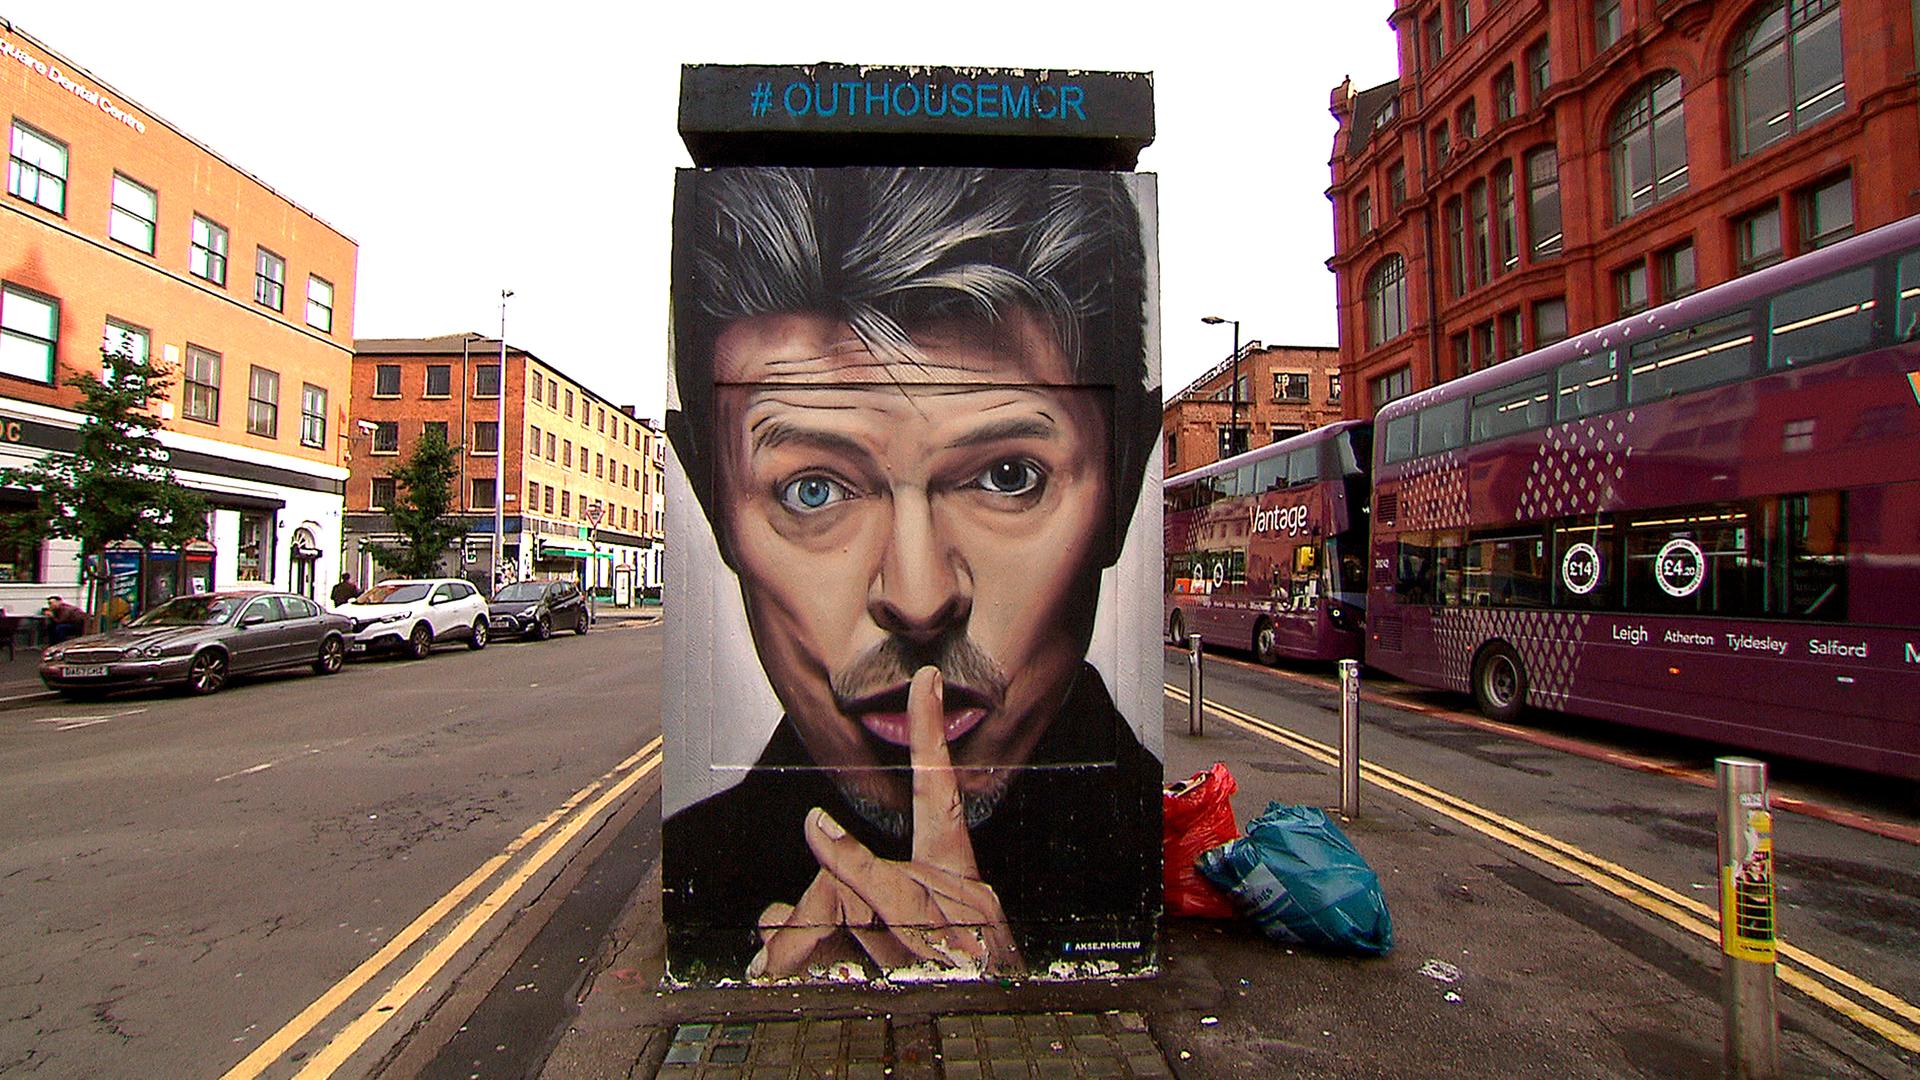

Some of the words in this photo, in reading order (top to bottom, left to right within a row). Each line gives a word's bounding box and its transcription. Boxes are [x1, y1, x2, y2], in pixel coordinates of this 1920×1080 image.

[47, 65, 99, 106] Dental
[97, 96, 146, 135] Centre
[751, 81, 773, 118] #
[783, 80, 1087, 121] OUTHOUSEMCR
[1249, 504, 1308, 537] Vantage
[1569, 561, 1592, 576] £14
[1612, 624, 1648, 645] Leigh
[1663, 629, 1715, 646] Atherton
[1725, 633, 1788, 655] Tyldesley
[1808, 638, 1868, 658] Salford
